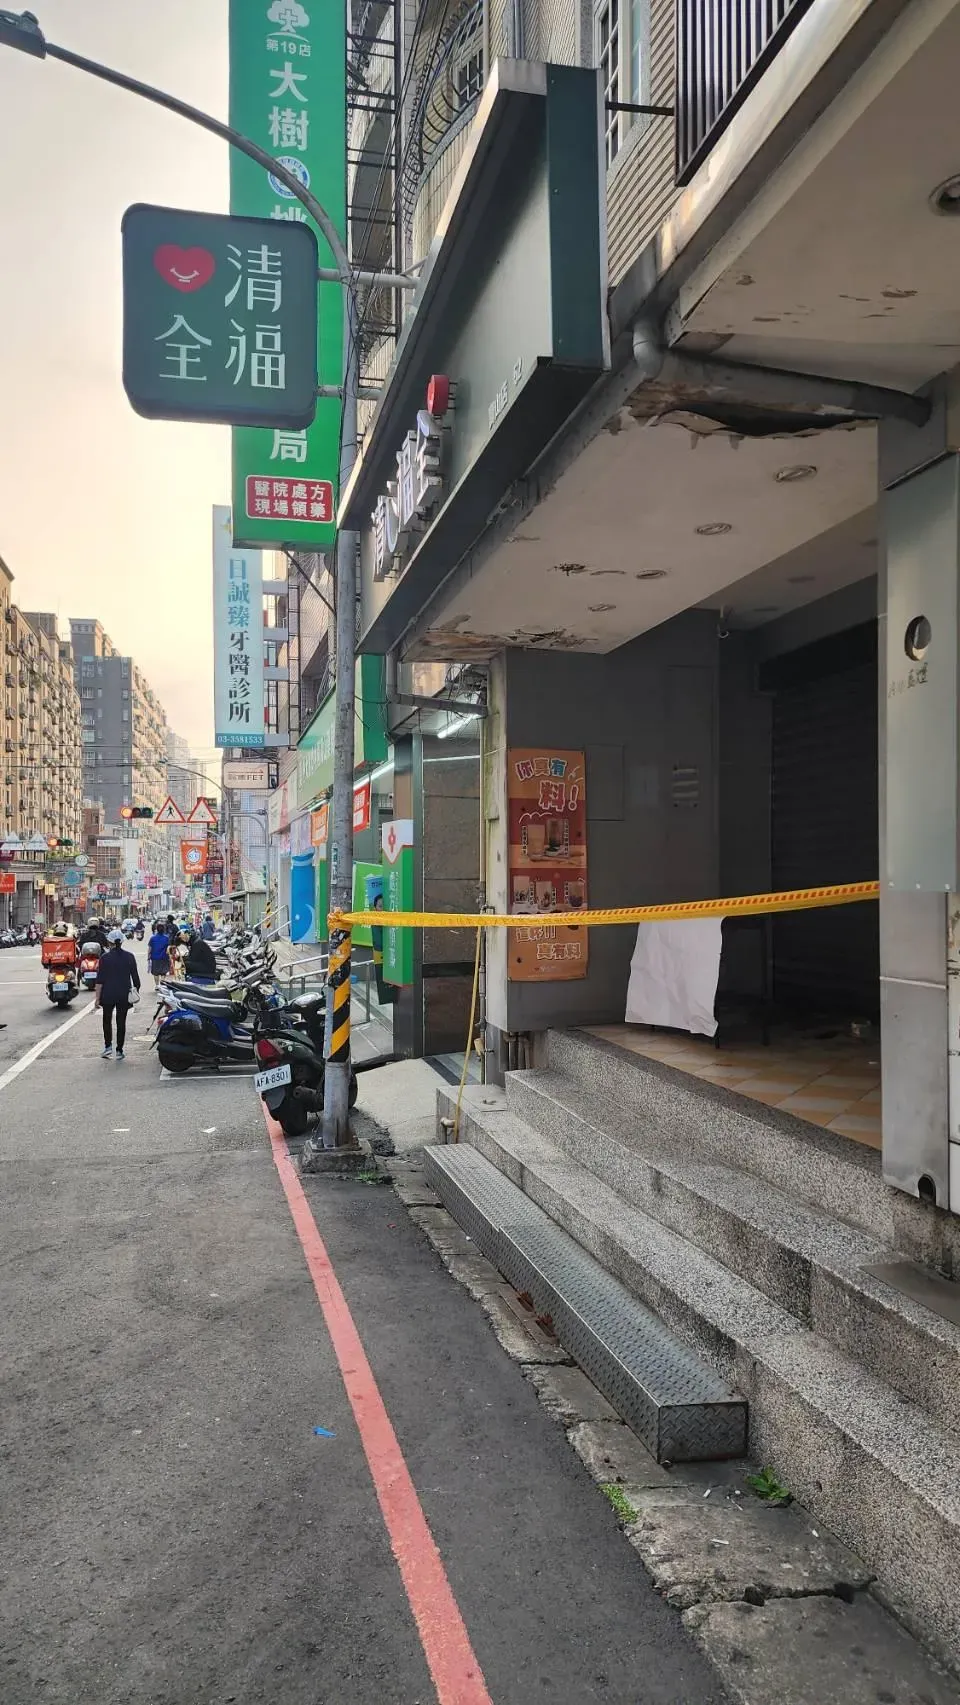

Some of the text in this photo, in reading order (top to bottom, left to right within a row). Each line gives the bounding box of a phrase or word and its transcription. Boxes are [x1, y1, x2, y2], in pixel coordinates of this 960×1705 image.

[266, 38, 311, 57] 第19店
[268, 61, 310, 152] 大樹
[254, 480, 326, 501] 醫院處方
[254, 498, 326, 518] 現場領藥
[217, 735, 263, 744] 03-3581533
[536, 942, 582, 960] 真有料
[256, 1070, 289, 1088] AFA-8301
